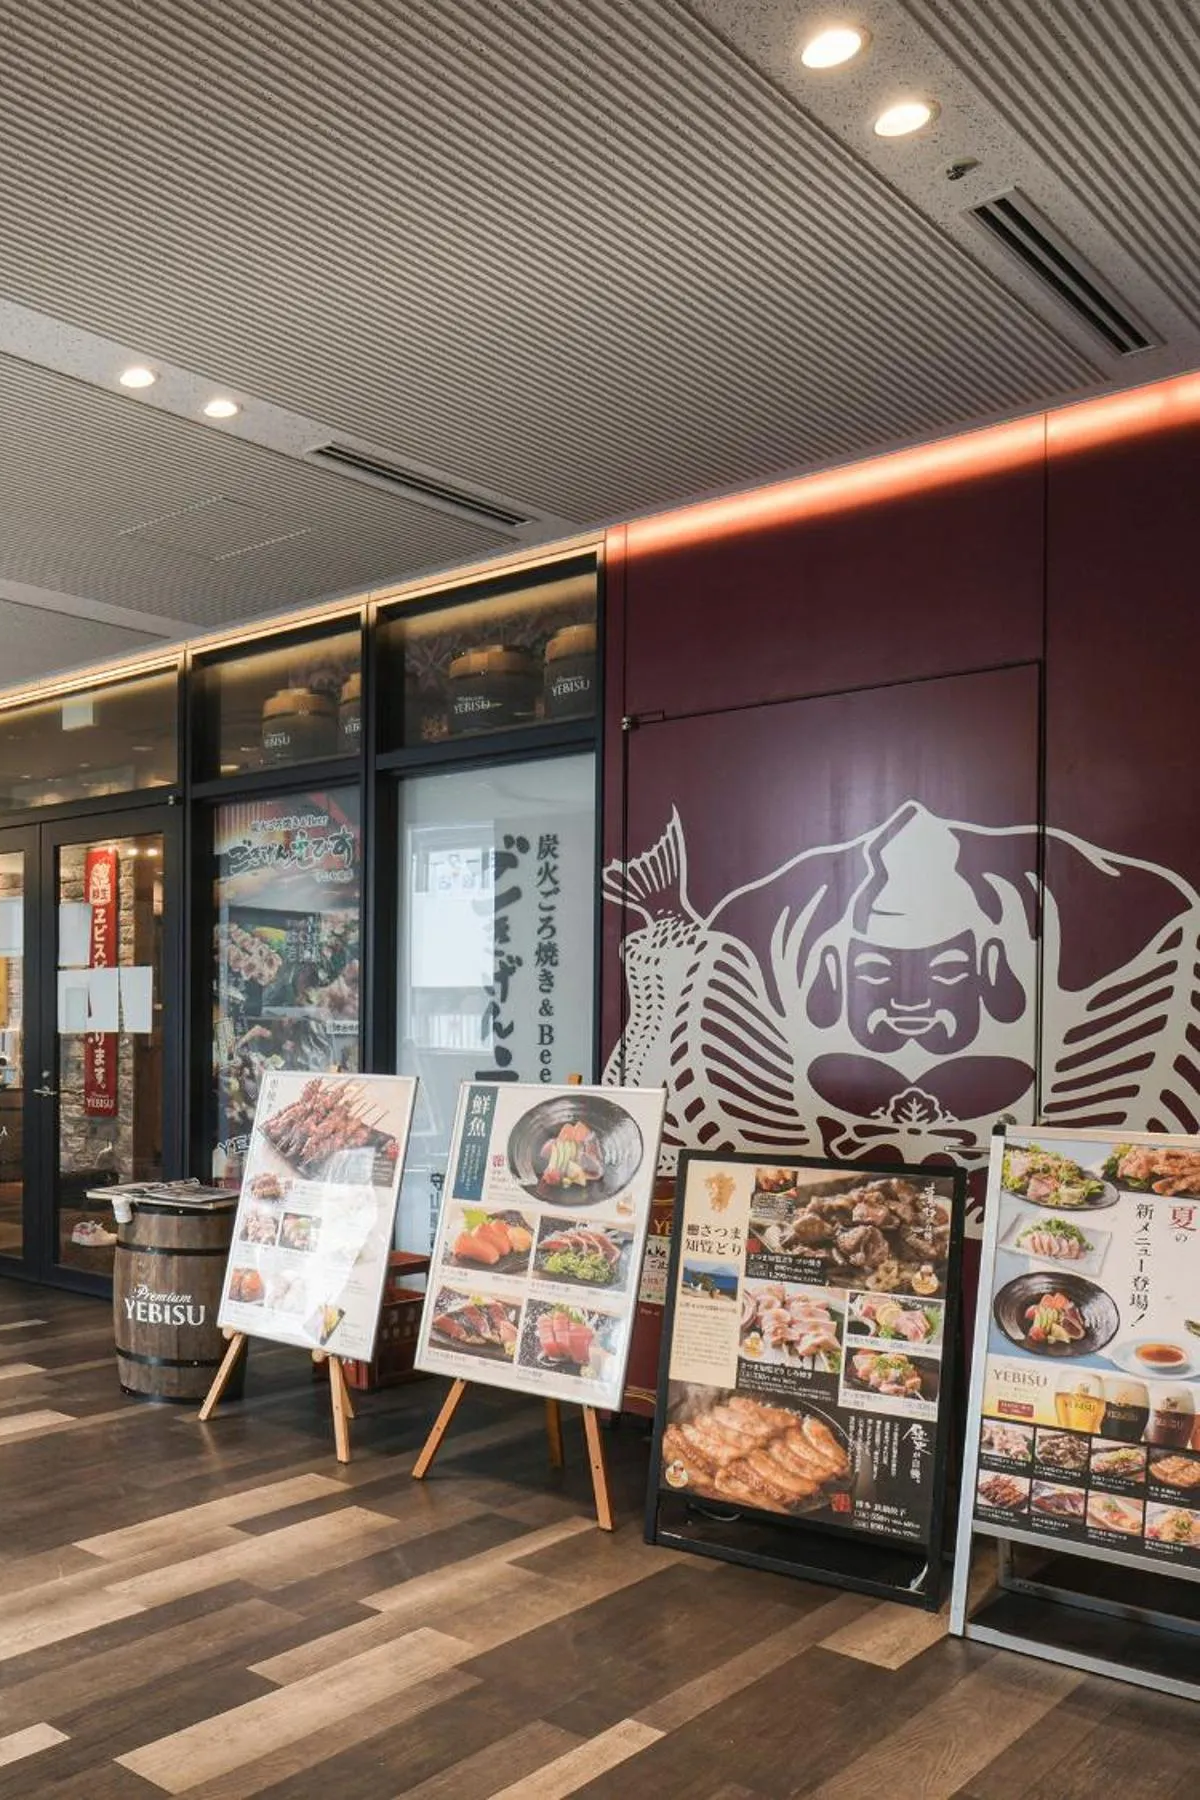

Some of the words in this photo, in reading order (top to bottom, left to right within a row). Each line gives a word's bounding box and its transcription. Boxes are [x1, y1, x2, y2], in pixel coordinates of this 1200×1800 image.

[552, 679, 591, 697] YEBISU
[454, 700, 490, 714] YEBISU
[467, 1095, 491, 1137] 鮮魚
[1169, 1205, 1197, 1242] 夏の
[130, 1283, 192, 1302] Premium
[124, 1298, 206, 1326] YEBISU
[993, 1369, 1048, 1388] YEBISU
